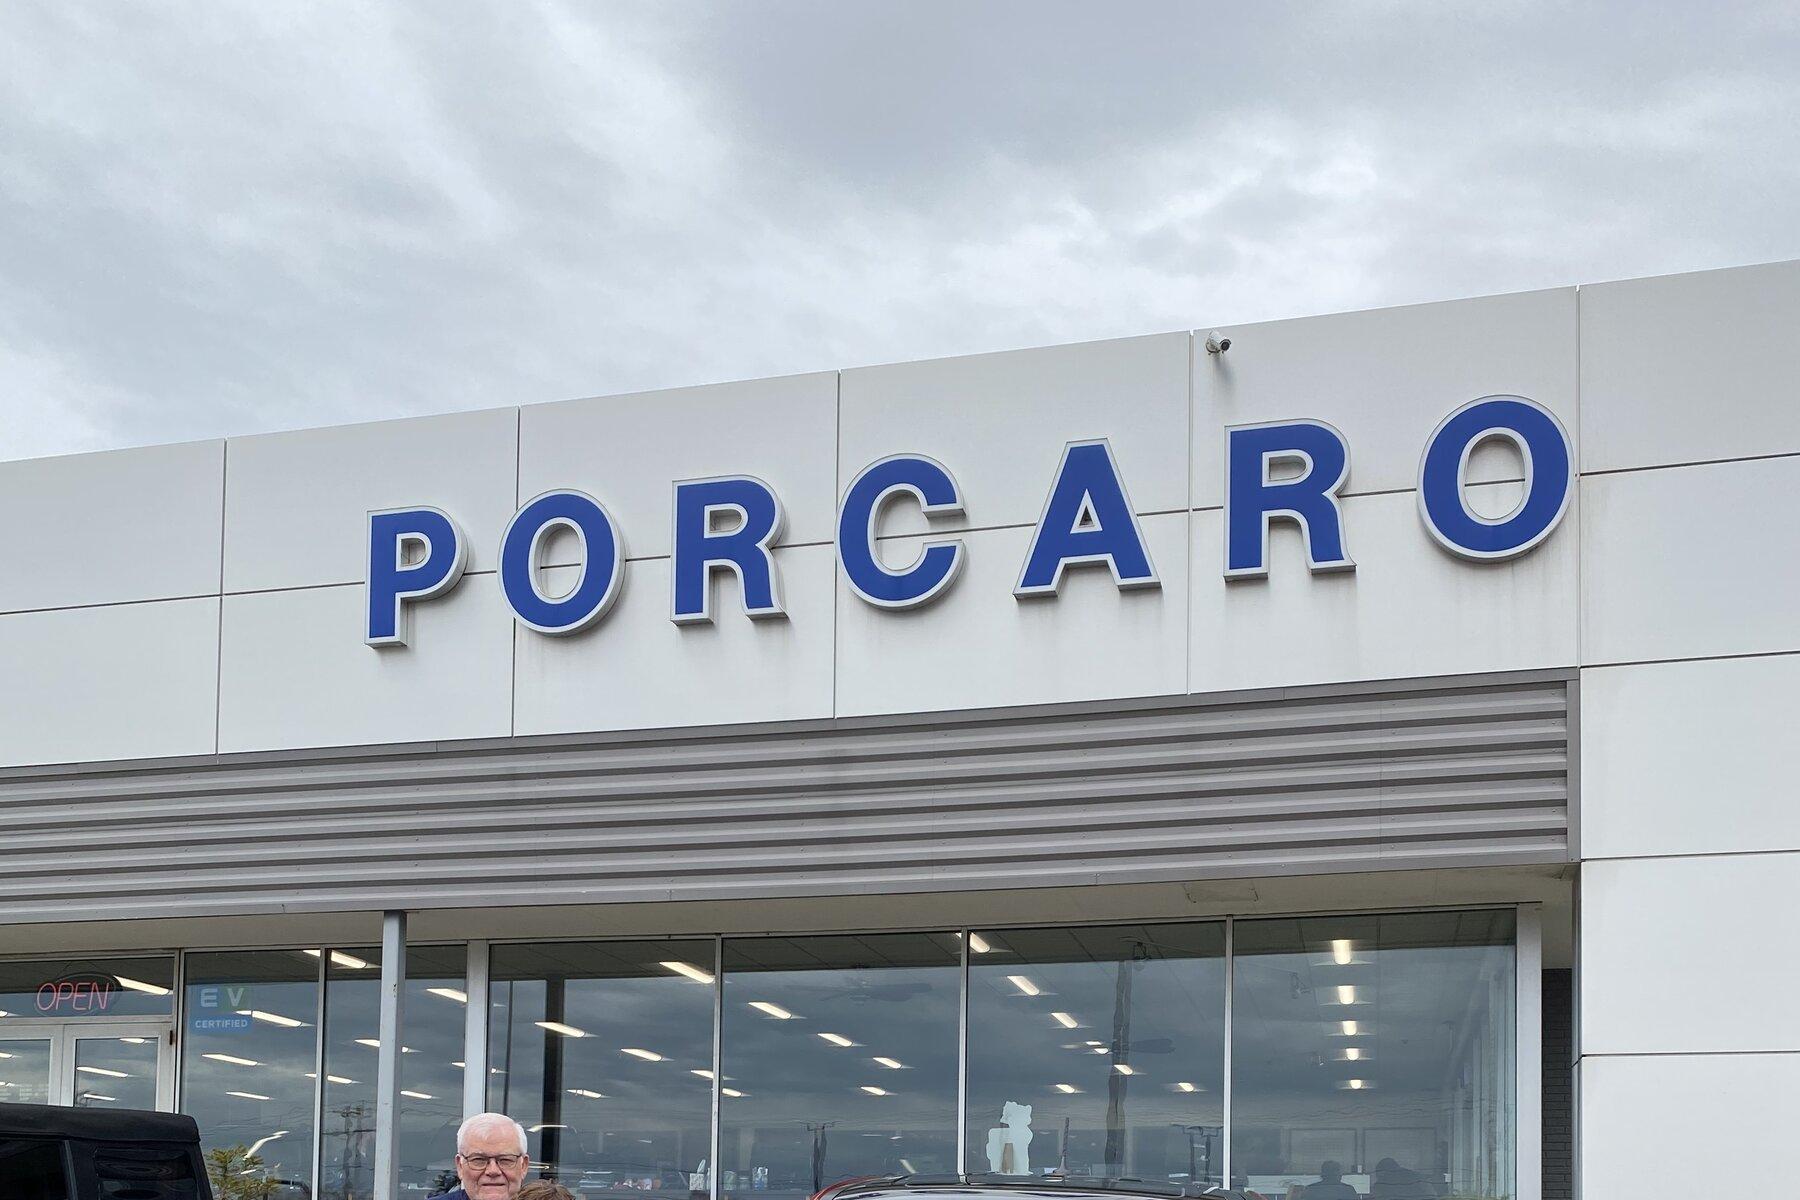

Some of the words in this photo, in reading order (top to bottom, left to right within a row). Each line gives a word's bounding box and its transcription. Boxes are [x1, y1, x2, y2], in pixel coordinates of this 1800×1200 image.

[363, 393, 1576, 649] PORCARO
[36, 981, 110, 1011] OPEN
[194, 1019, 249, 1029] CERTIFIED
